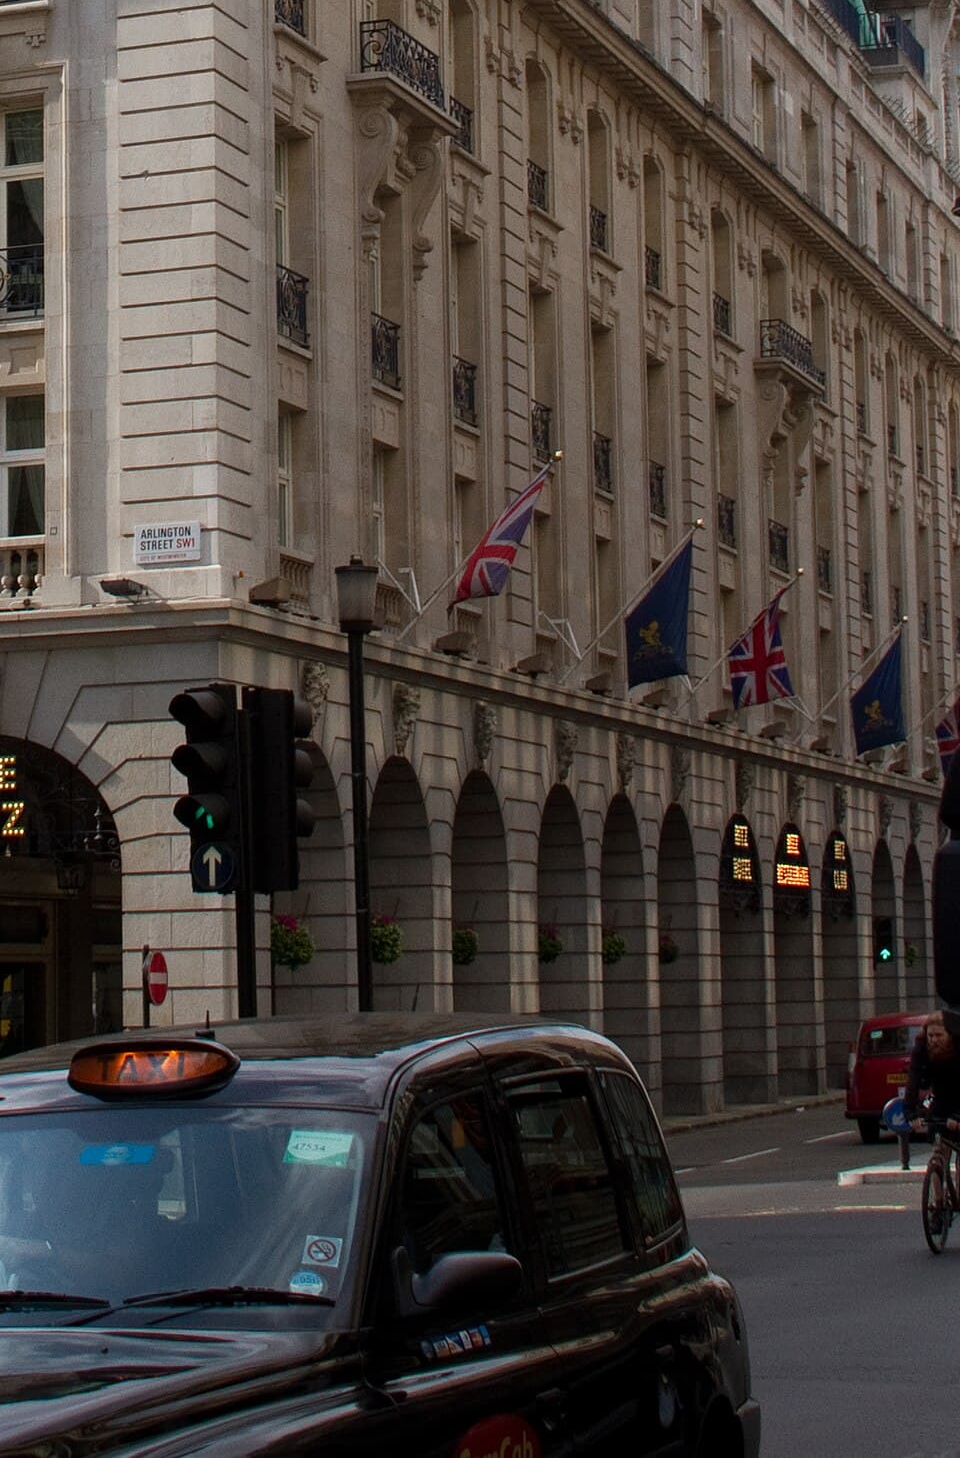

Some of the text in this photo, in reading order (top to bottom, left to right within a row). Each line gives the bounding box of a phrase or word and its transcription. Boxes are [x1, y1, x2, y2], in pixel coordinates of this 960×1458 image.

[141, 526, 191, 539] ARLINGTON
[140, 538, 195, 551] STREET SW1
[97, 1052, 185, 1081] TAXI
